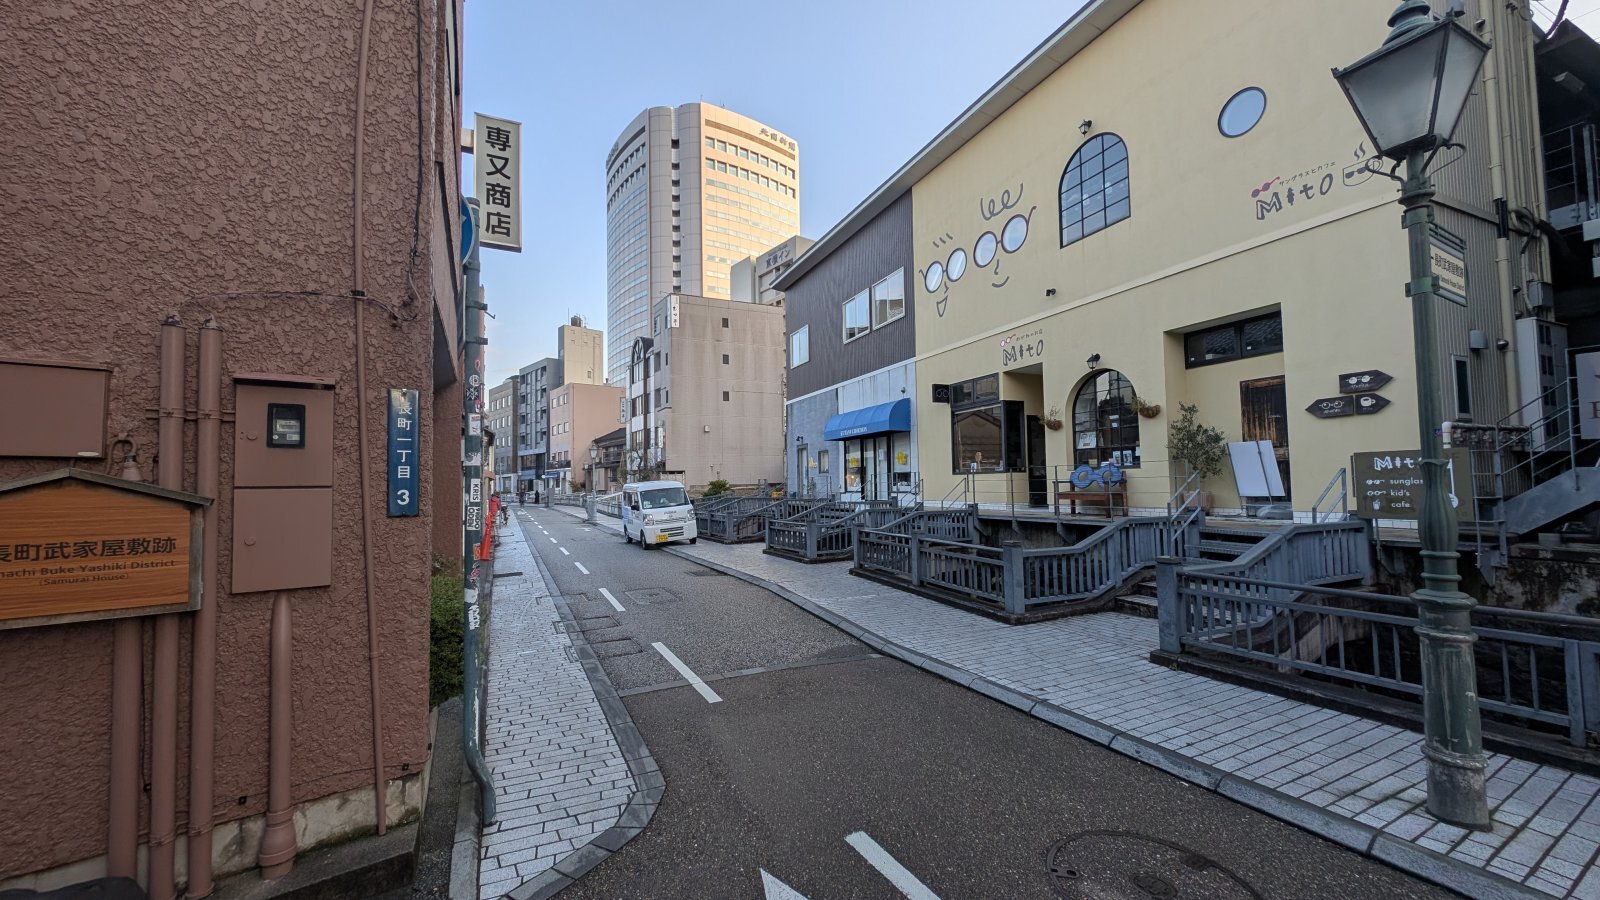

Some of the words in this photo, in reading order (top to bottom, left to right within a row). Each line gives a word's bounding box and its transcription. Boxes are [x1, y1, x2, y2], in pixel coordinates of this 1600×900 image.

[485, 125, 511, 237] 専又商店
[396, 402, 412, 479] 長町一丁目
[1374, 456, 1421, 470] Mit
[397, 490, 410, 505] 3
[1391, 500, 1411, 508] cafe
[40, 567, 75, 576] Buke
[80, 561, 126, 572] Yashiki
[131, 560, 176, 570] District
